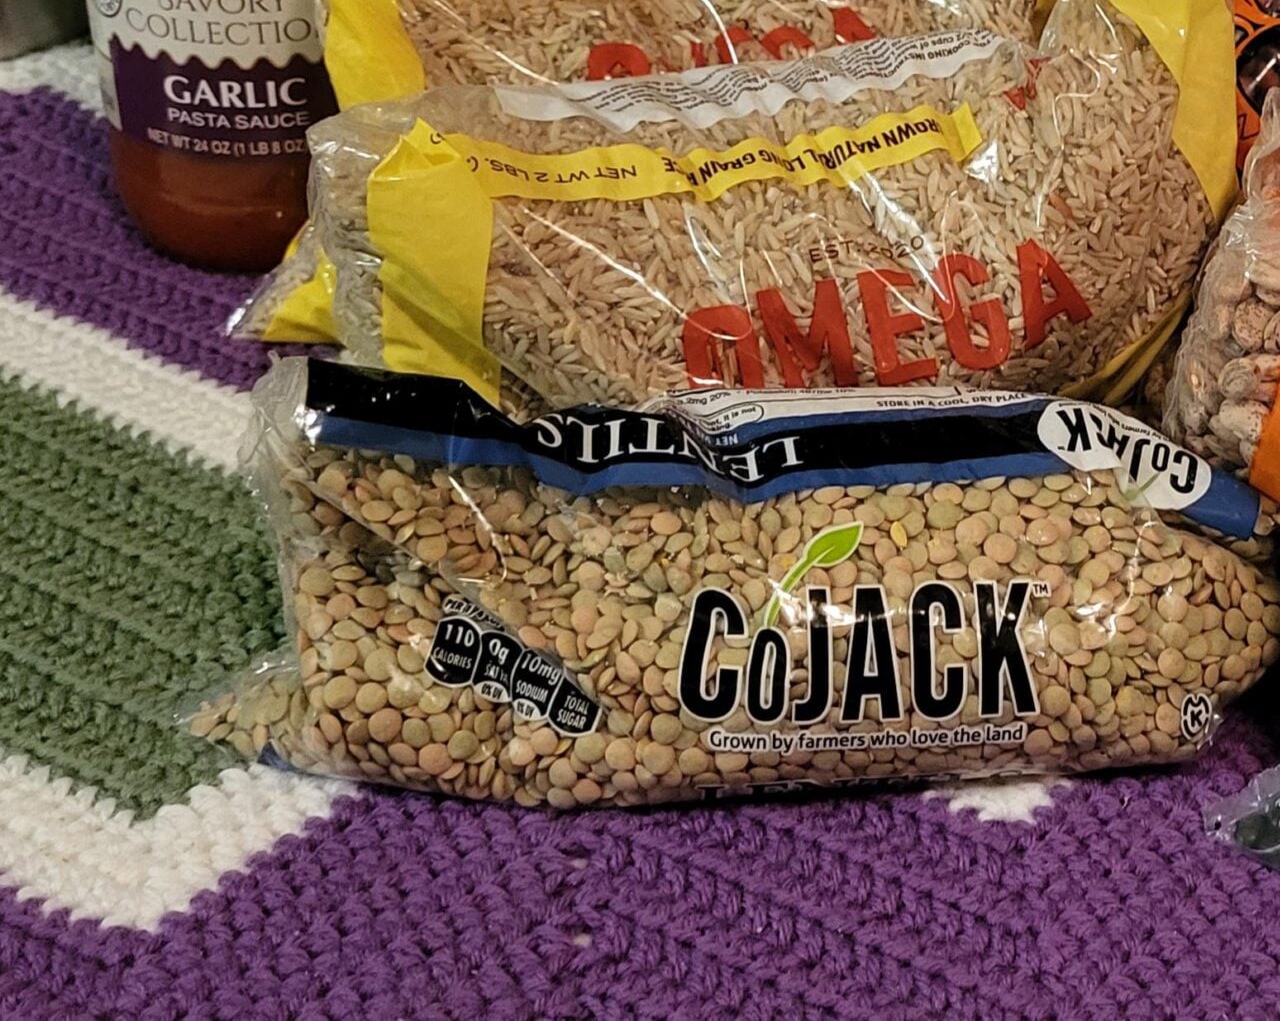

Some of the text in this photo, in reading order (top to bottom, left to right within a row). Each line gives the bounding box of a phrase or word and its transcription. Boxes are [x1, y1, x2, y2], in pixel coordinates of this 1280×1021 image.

[163, 75, 307, 108] GARLIC
[167, 107, 311, 129] PASTA SAUCE
[148, 127, 269, 155] NET WT 24 OZ LB
[882, 119, 940, 147] ROWN
[485, 158, 530, 182] LBS.
[532, 172, 548, 182] 2
[555, 169, 591, 184] WT
[594, 165, 637, 178] NET
[699, 153, 756, 185] GRAIN
[683, 238, 1092, 388] OMEGA
[938, 398, 969, 407] COOL,
[973, 396, 992, 404] DRY
[997, 392, 1027, 403] PLACE
[531, 413, 803, 483] LENTILS
[716, 433, 738, 446] NET
[445, 623, 474, 647] 110
[433, 646, 472, 670] CALORIES
[489, 638, 510, 665] 0g
[521, 652, 562, 686] 10mg
[516, 680, 549, 703] SODIUM
[564, 695, 590, 716] TOTAL
[556, 709, 586, 729] SUGAR
[710, 725, 1023, 753] Grown by farmers who love the land
